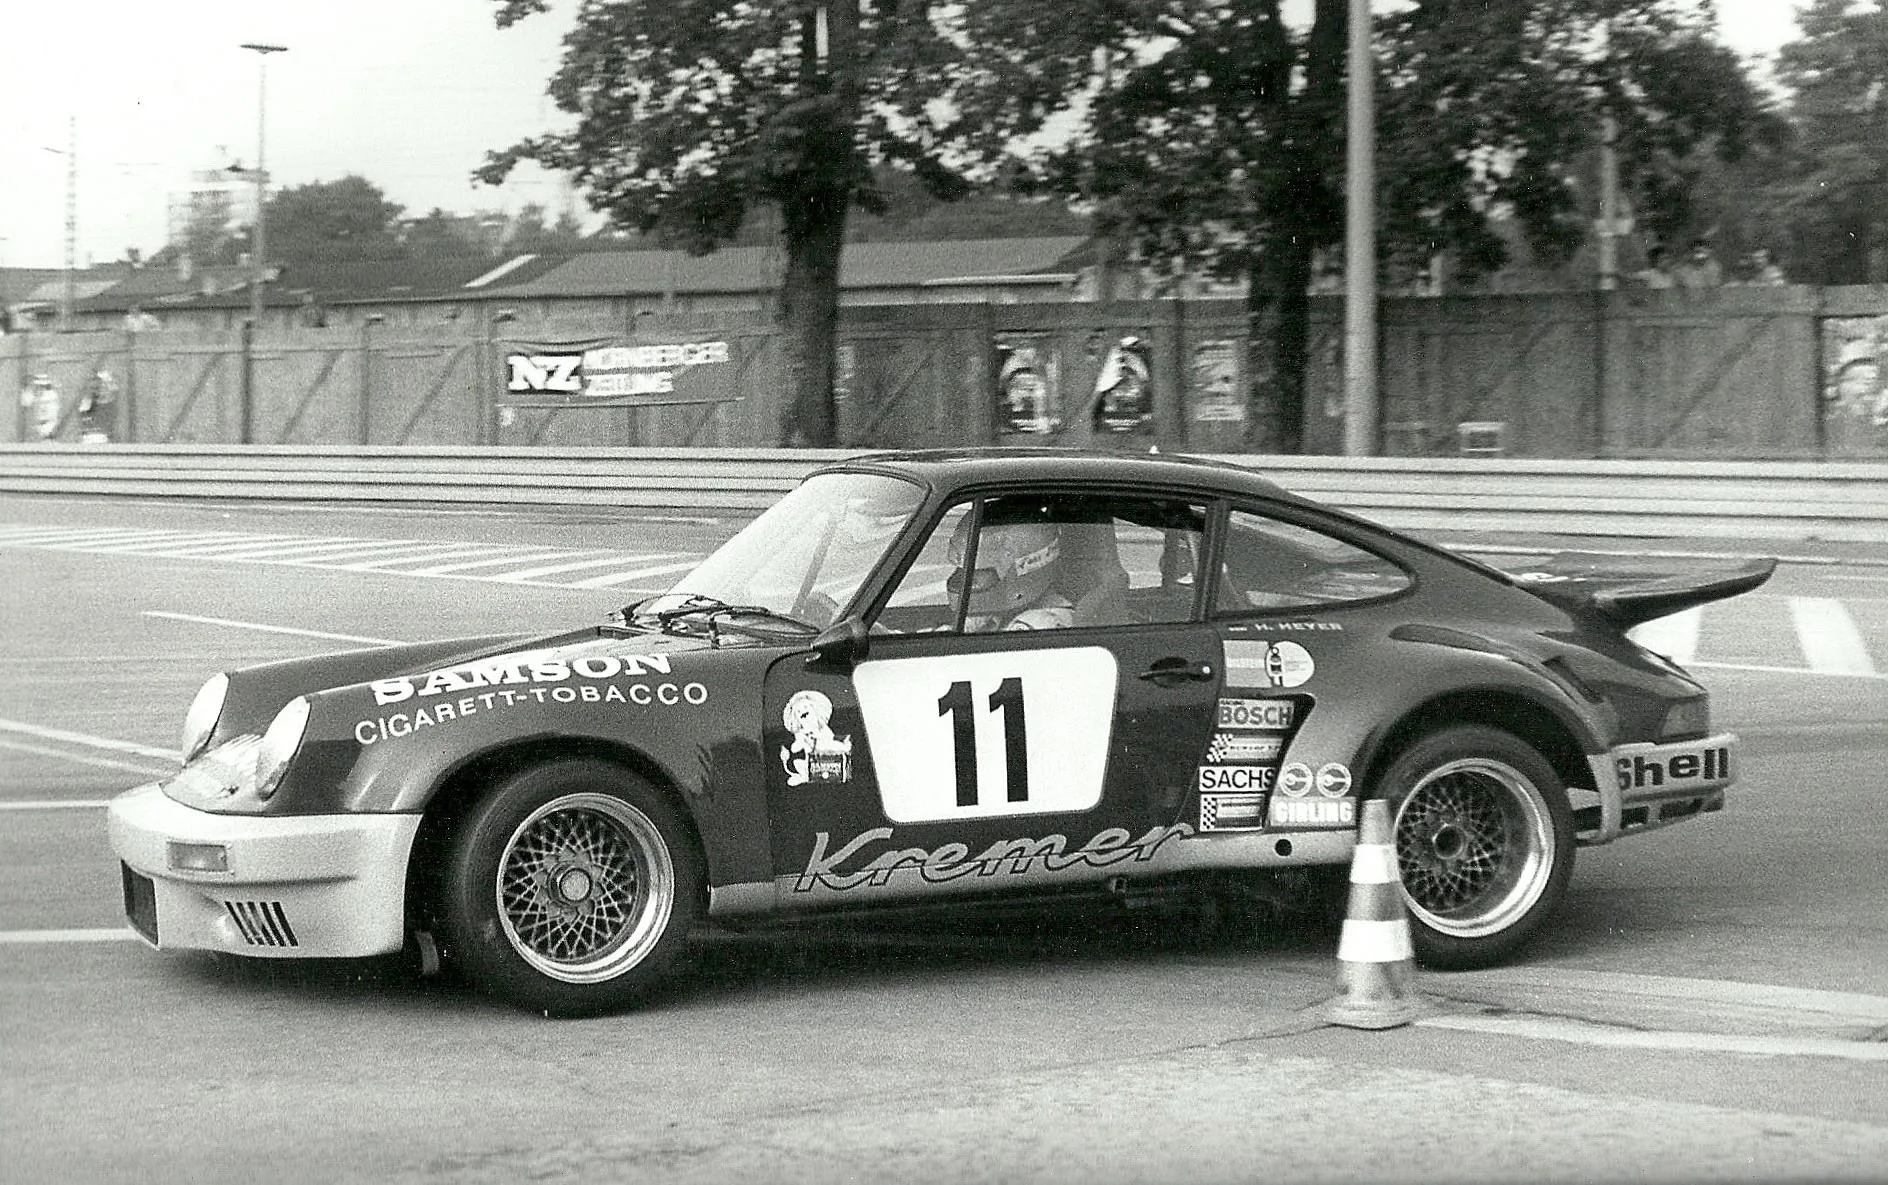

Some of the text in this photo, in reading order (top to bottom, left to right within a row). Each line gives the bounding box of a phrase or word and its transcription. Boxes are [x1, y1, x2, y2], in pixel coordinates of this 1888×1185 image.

[507, 356, 582, 391] NZ
[371, 653, 671, 705] SAMSON
[355, 682, 708, 745] CIGARETT-TOBACCO
[1220, 706, 1293, 725] BOSCH
[938, 676, 1029, 807] 11
[1202, 769, 1275, 789] SACHS
[1616, 748, 1729, 791] Shell
[1275, 801, 1353, 823] GIRLING
[794, 821, 1195, 893] Kremer
